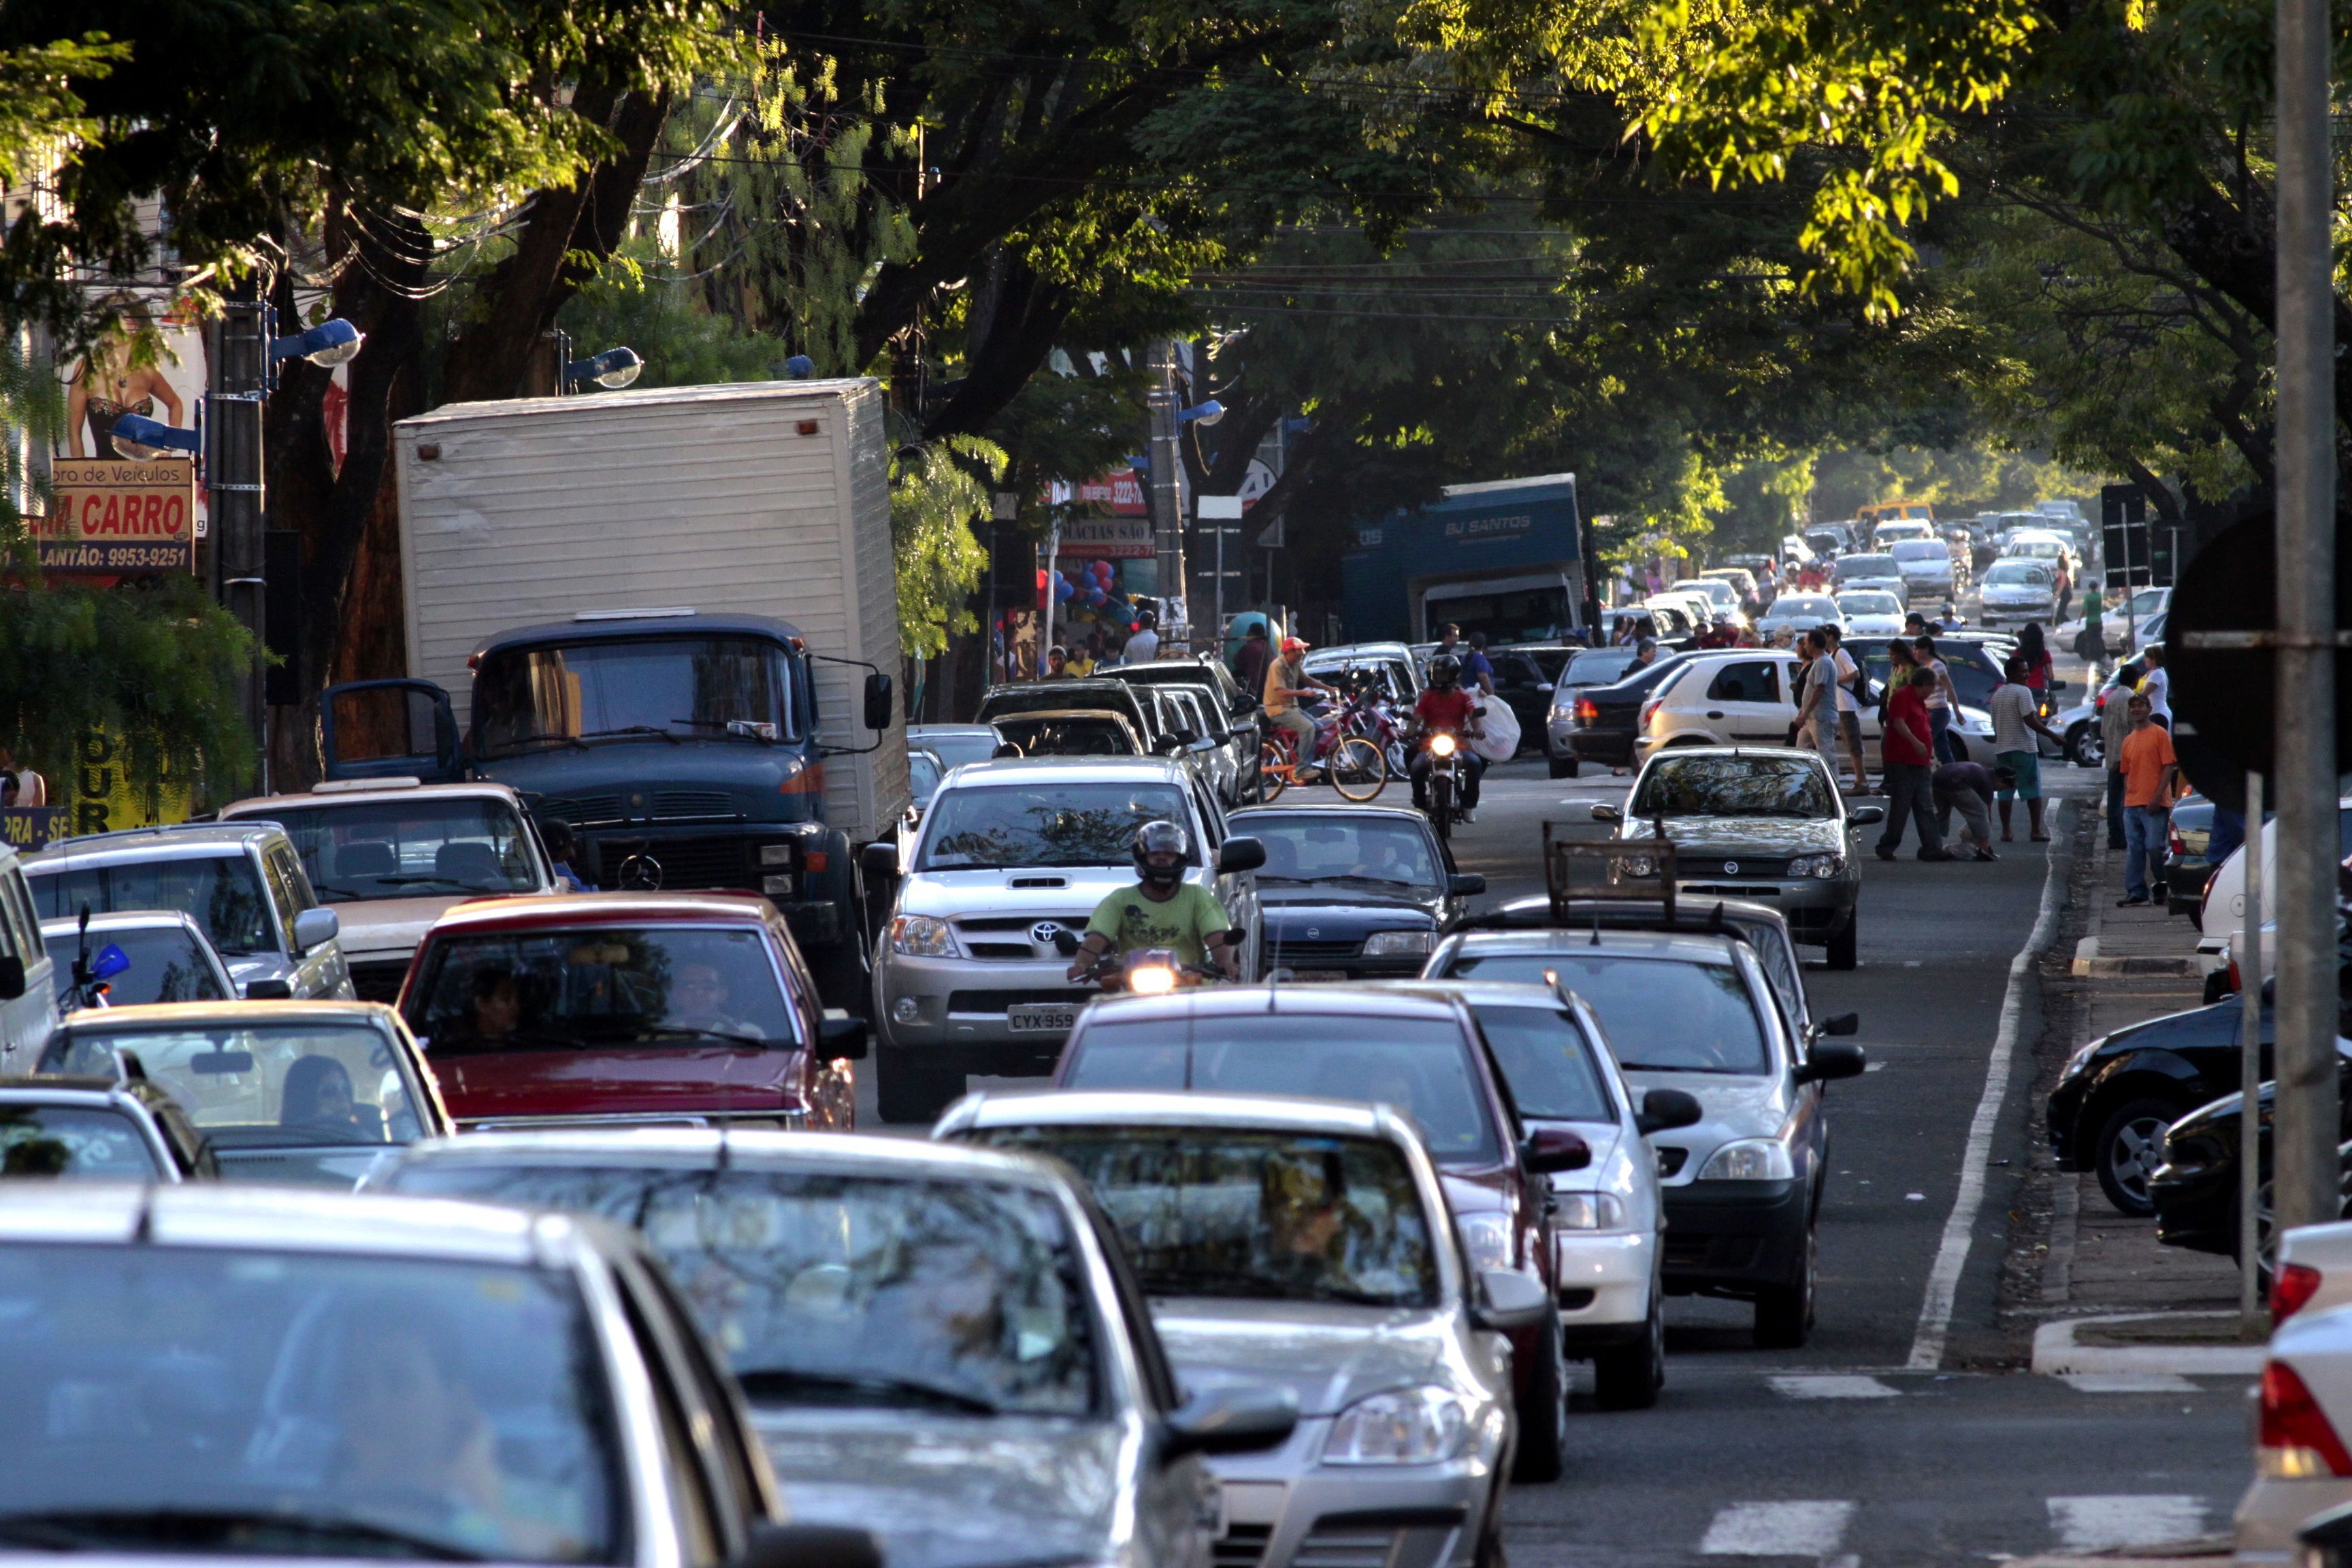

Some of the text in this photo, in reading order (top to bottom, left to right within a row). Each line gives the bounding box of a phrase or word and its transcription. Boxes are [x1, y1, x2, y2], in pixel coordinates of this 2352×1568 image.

[84, 466, 105, 482] de
[82, 494, 184, 535] CARRO
[196, 519, 206, 532] g
[1468, 515, 1531, 533] SANTOS
[108, 548, 186, 567] 9953-9251
